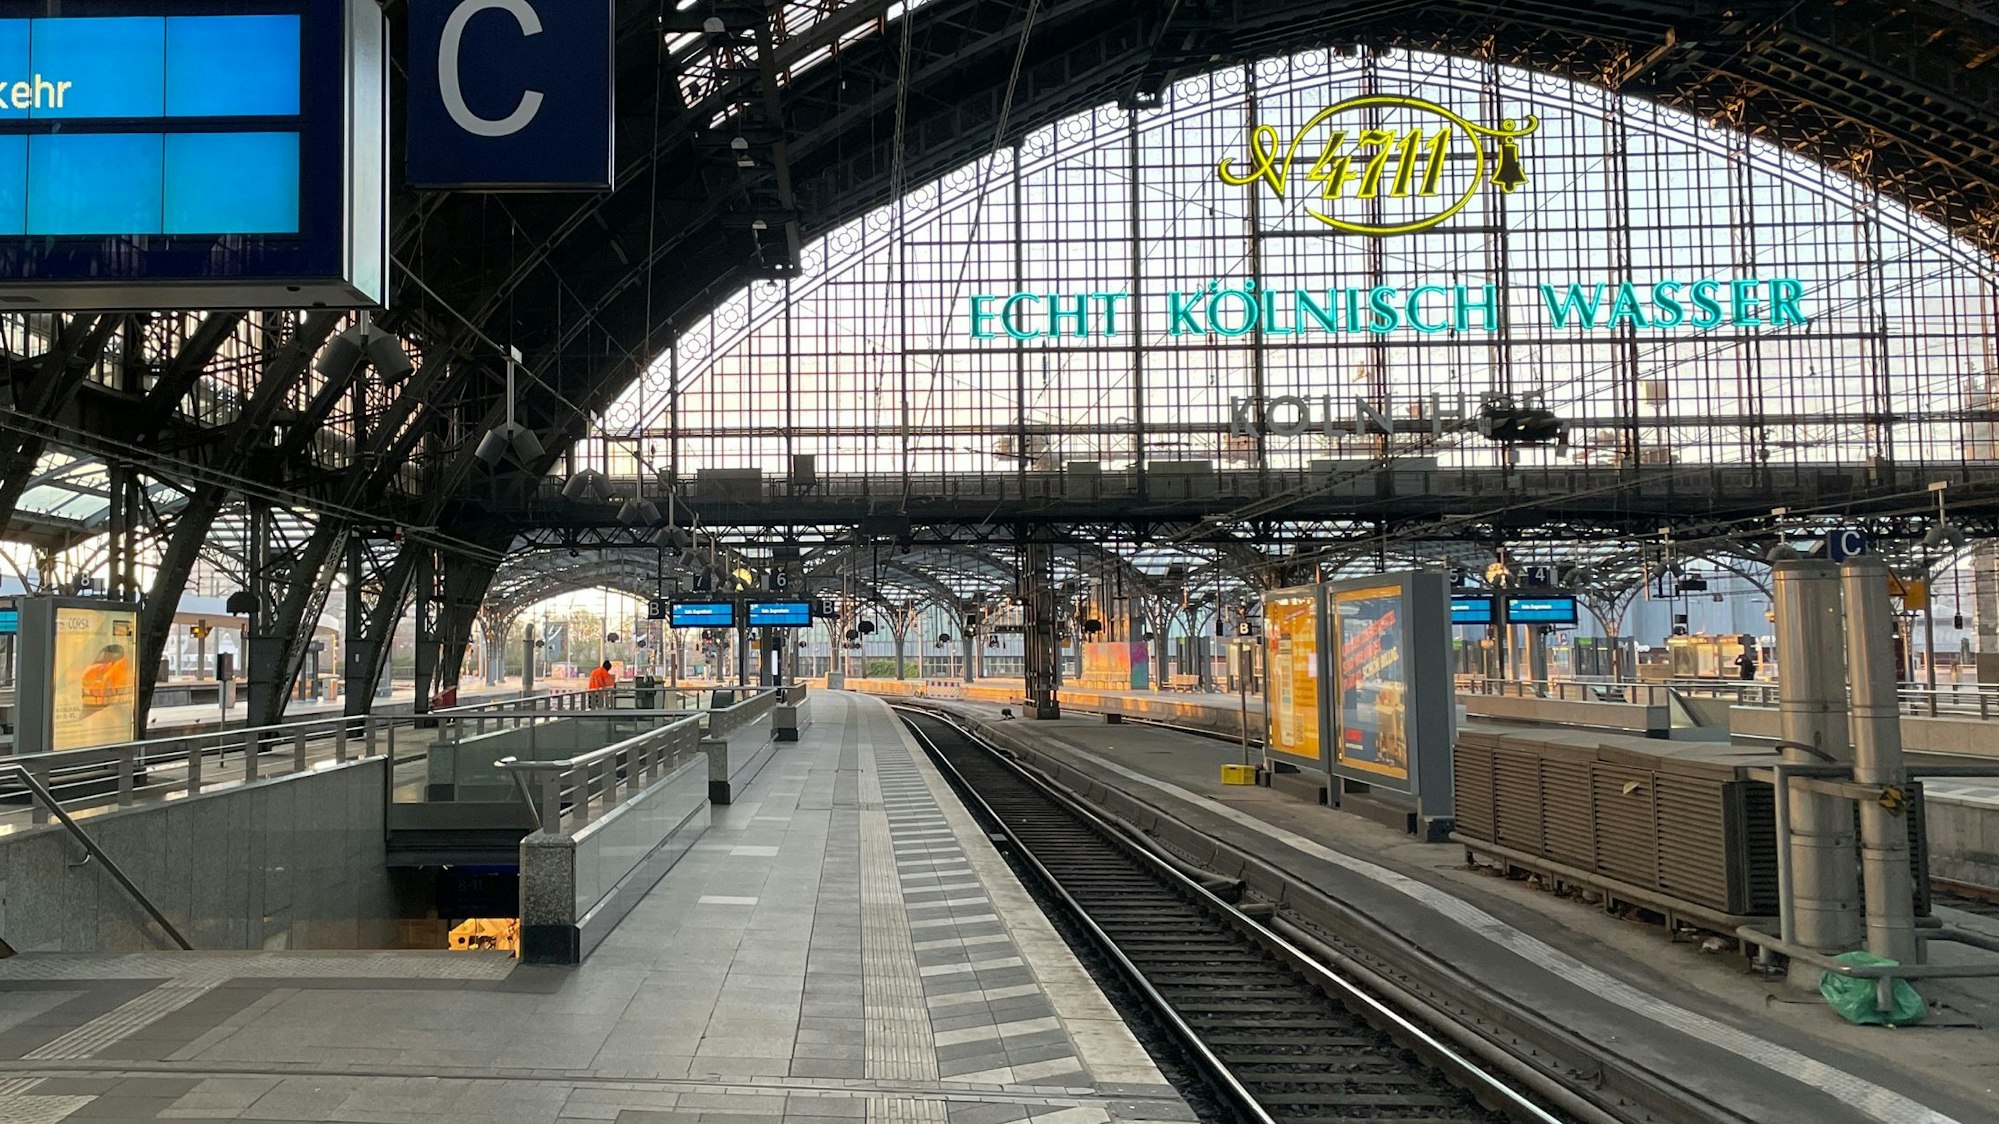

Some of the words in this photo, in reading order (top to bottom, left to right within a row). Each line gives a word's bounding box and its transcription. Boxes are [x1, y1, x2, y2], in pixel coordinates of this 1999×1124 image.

[438, 0, 544, 136] C
[1306, 128, 1452, 199] 4711
[969, 292, 1128, 340] ECHT
[1169, 277, 1498, 337] KÖLNISCH
[1541, 278, 1808, 330] WASSER
[1841, 531, 1861, 556] C
[81, 573, 90, 586] 8
[777, 572, 787, 587] 6
[1535, 568, 1546, 581] 4
[649, 602, 660, 616] B
[822, 601, 834, 615] B
[1239, 623, 1249, 635] B
